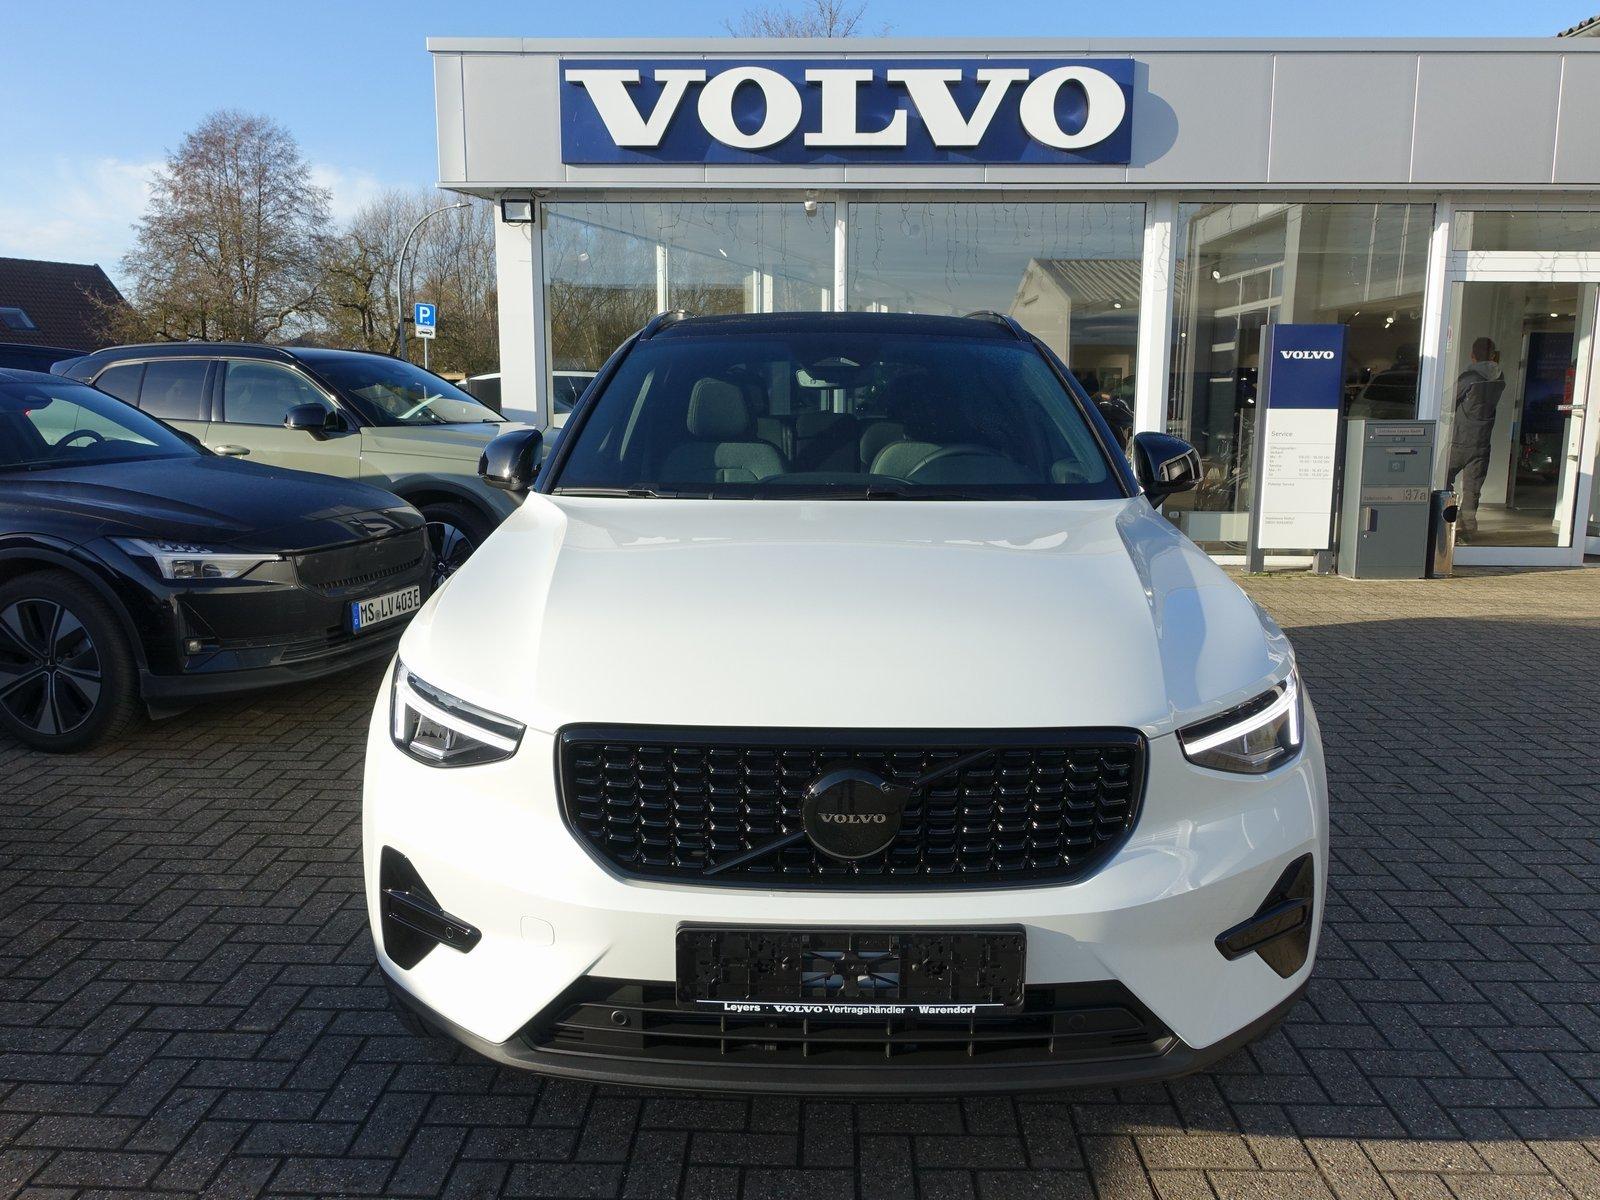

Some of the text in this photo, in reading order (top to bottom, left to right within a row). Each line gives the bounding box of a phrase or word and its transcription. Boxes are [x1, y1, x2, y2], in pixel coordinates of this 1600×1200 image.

[564, 66, 1126, 149] VOLVO
[420, 306, 431, 323] P
[1280, 350, 1335, 360] VOLVO
[360, 602, 375, 625] MS
[817, 812, 888, 824] VOLVO
[724, 1002, 761, 1013] Leyers
[919, 1005, 977, 1014] Warendorf
